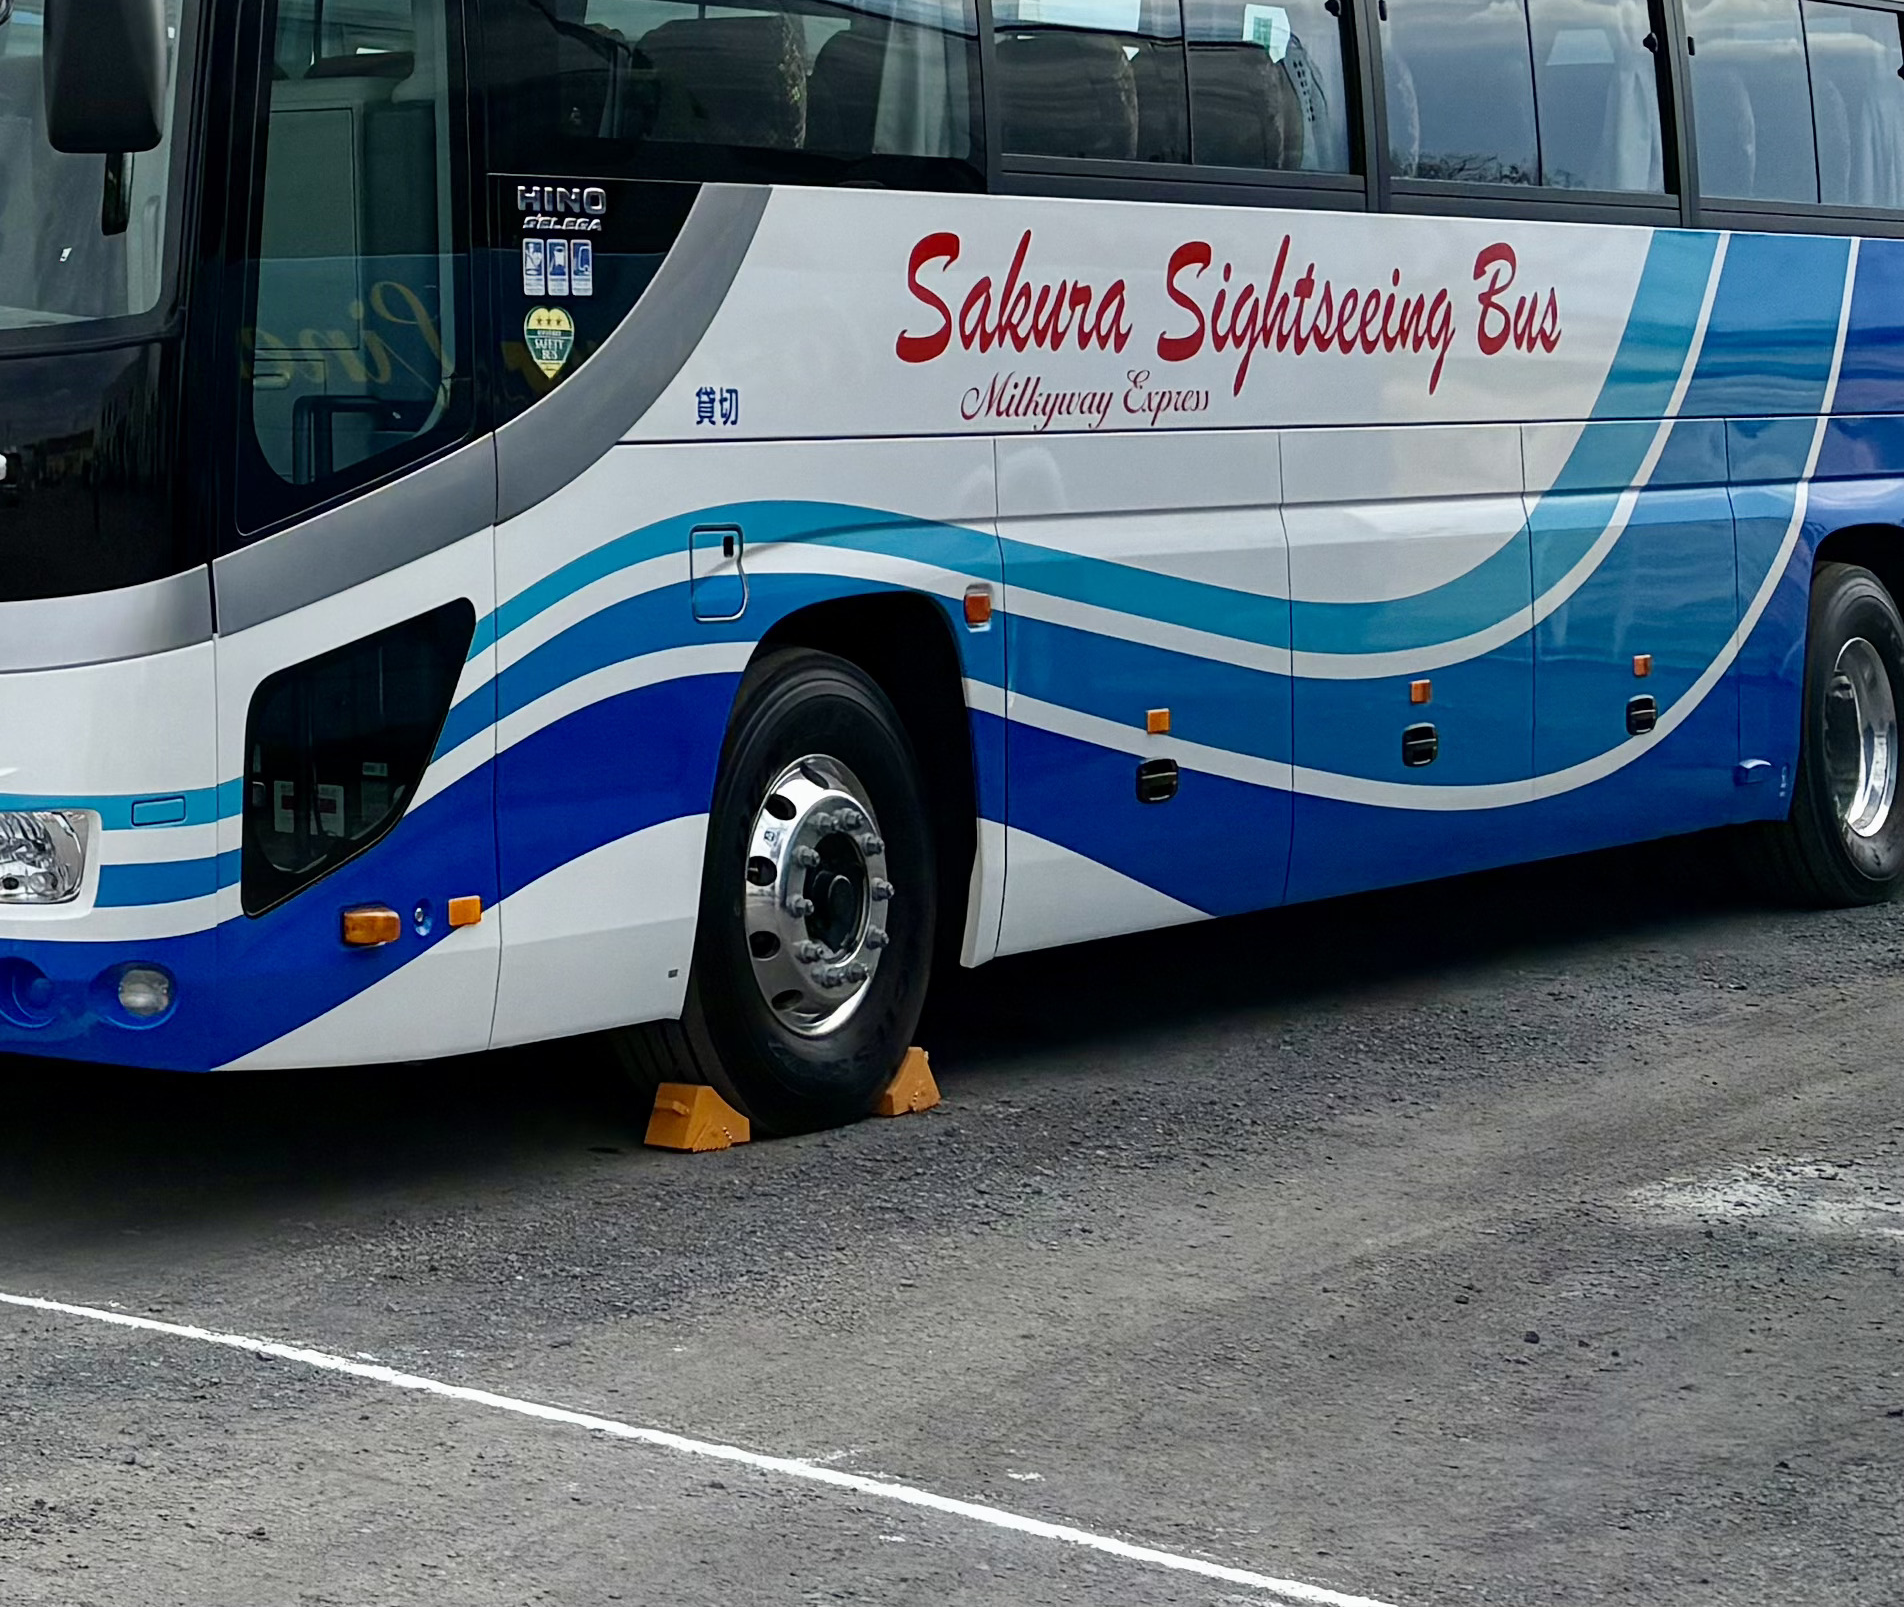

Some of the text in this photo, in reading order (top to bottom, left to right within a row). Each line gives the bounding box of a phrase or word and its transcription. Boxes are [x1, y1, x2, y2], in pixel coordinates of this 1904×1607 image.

[517, 185, 607, 215] HINO
[895, 228, 1562, 397] Sakura Sightseeing Bus
[695, 386, 739, 426] 貸切
[960, 369, 1210, 431] Milkyway Express
